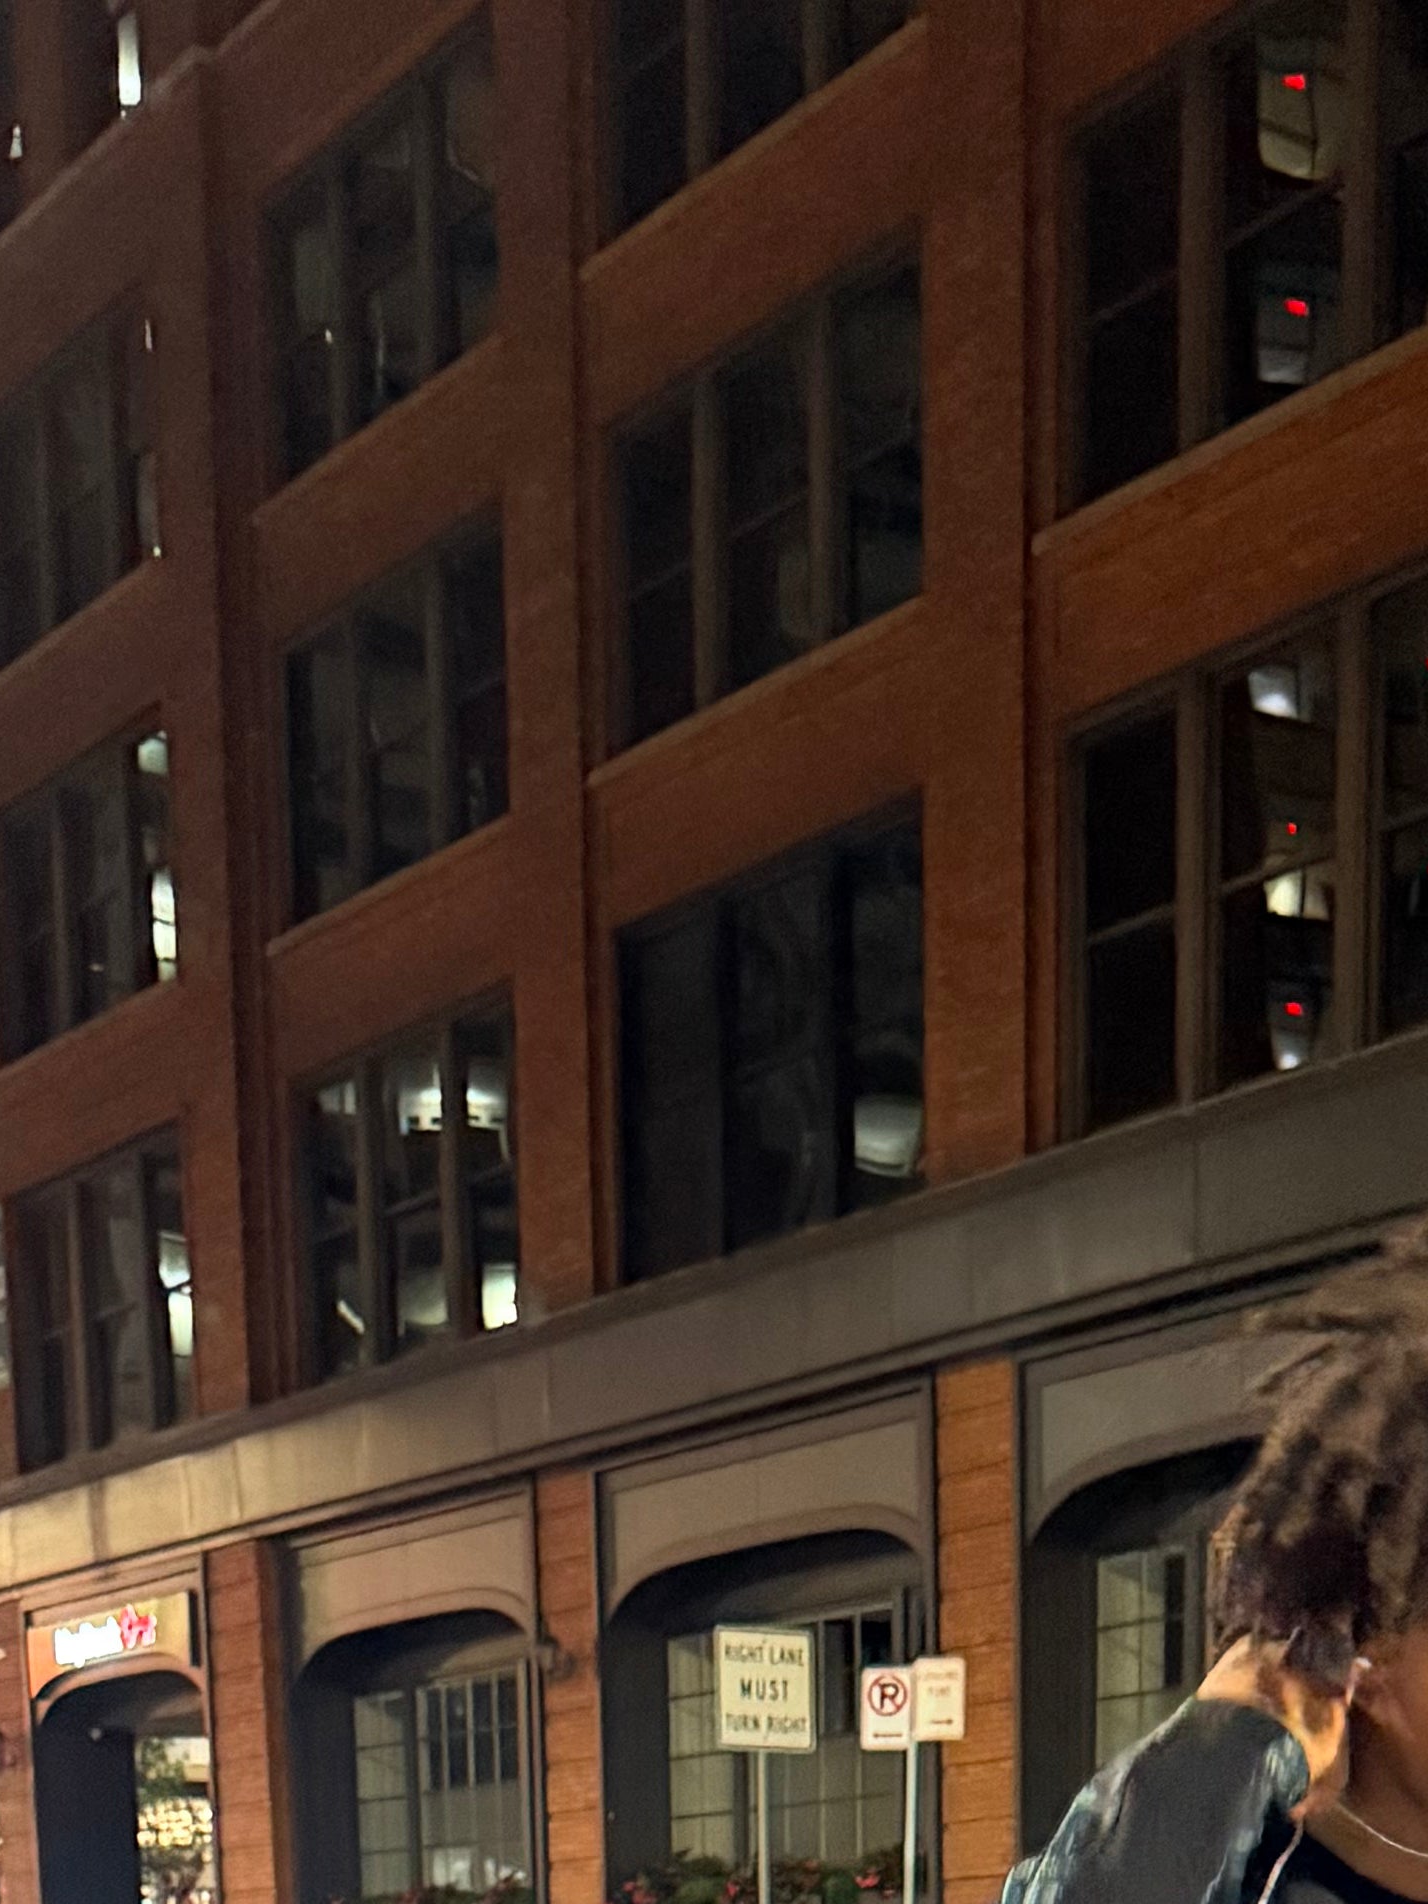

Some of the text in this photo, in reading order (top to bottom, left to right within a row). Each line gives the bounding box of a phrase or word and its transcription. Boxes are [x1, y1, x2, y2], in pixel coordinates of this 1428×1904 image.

[724, 1643, 805, 1666] RIGHT LANE
[740, 1678, 788, 1701] MUST
[725, 1713, 807, 1734] TURN RIGHT
